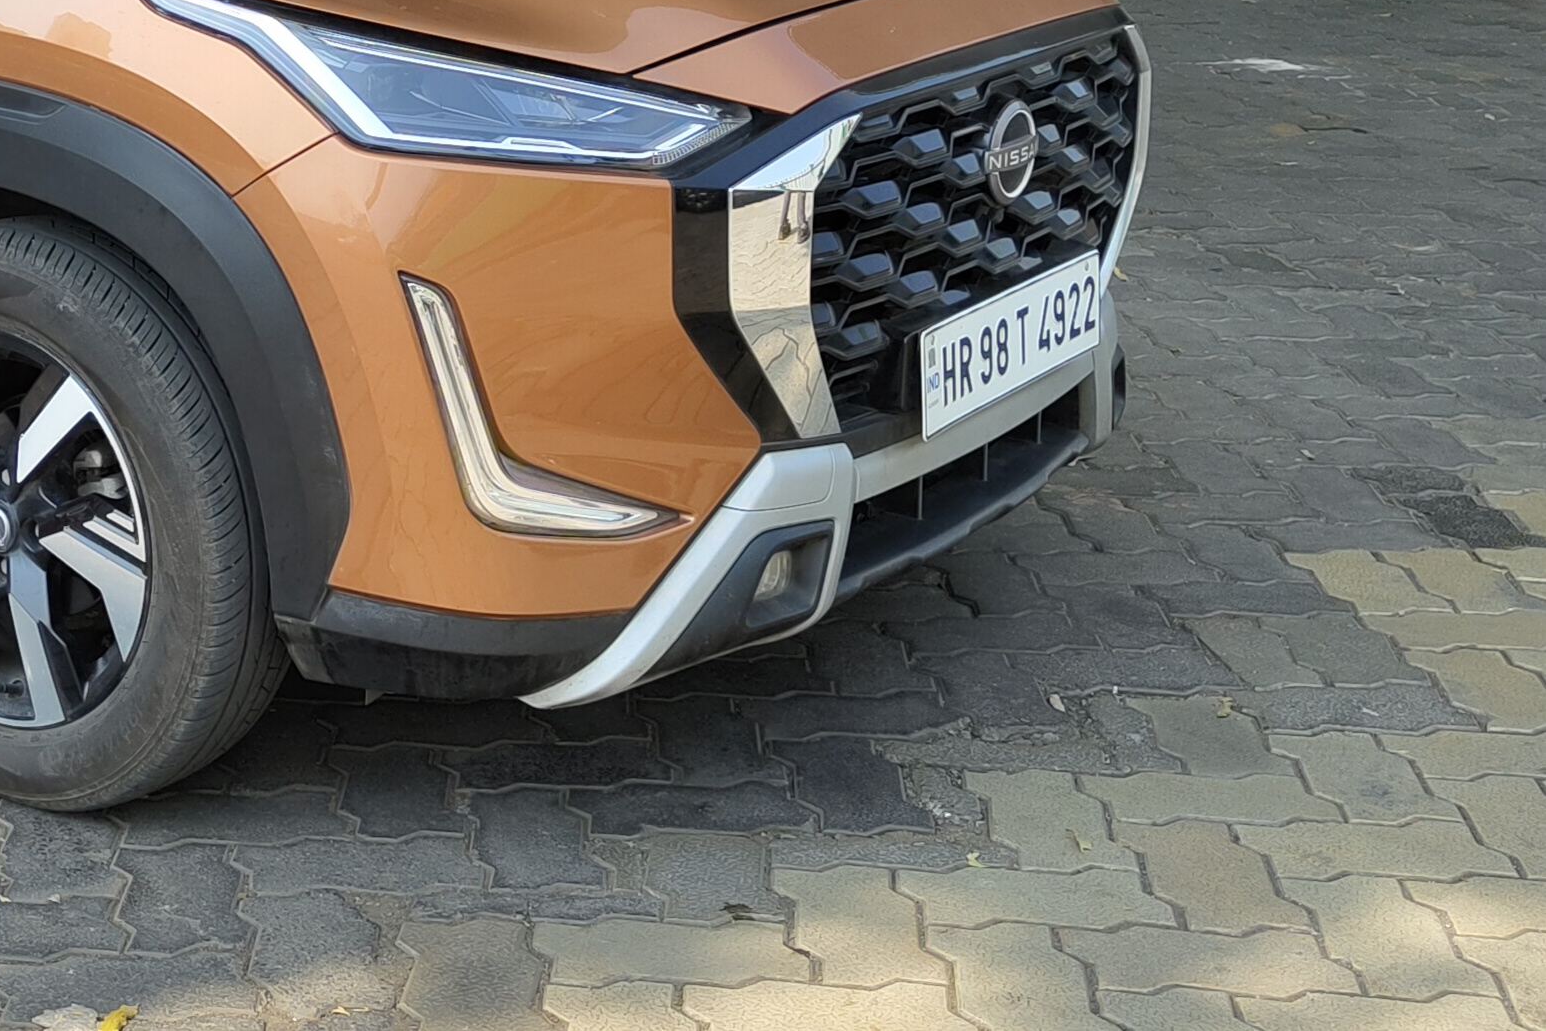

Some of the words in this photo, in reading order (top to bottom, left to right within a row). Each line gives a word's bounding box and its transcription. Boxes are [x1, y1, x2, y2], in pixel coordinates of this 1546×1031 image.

[942, 336, 973, 408] HR
[980, 318, 1010, 385] 98
[1016, 305, 1030, 365] T
[1038, 275, 1097, 353] 4922
[926, 372, 941, 394] IND
